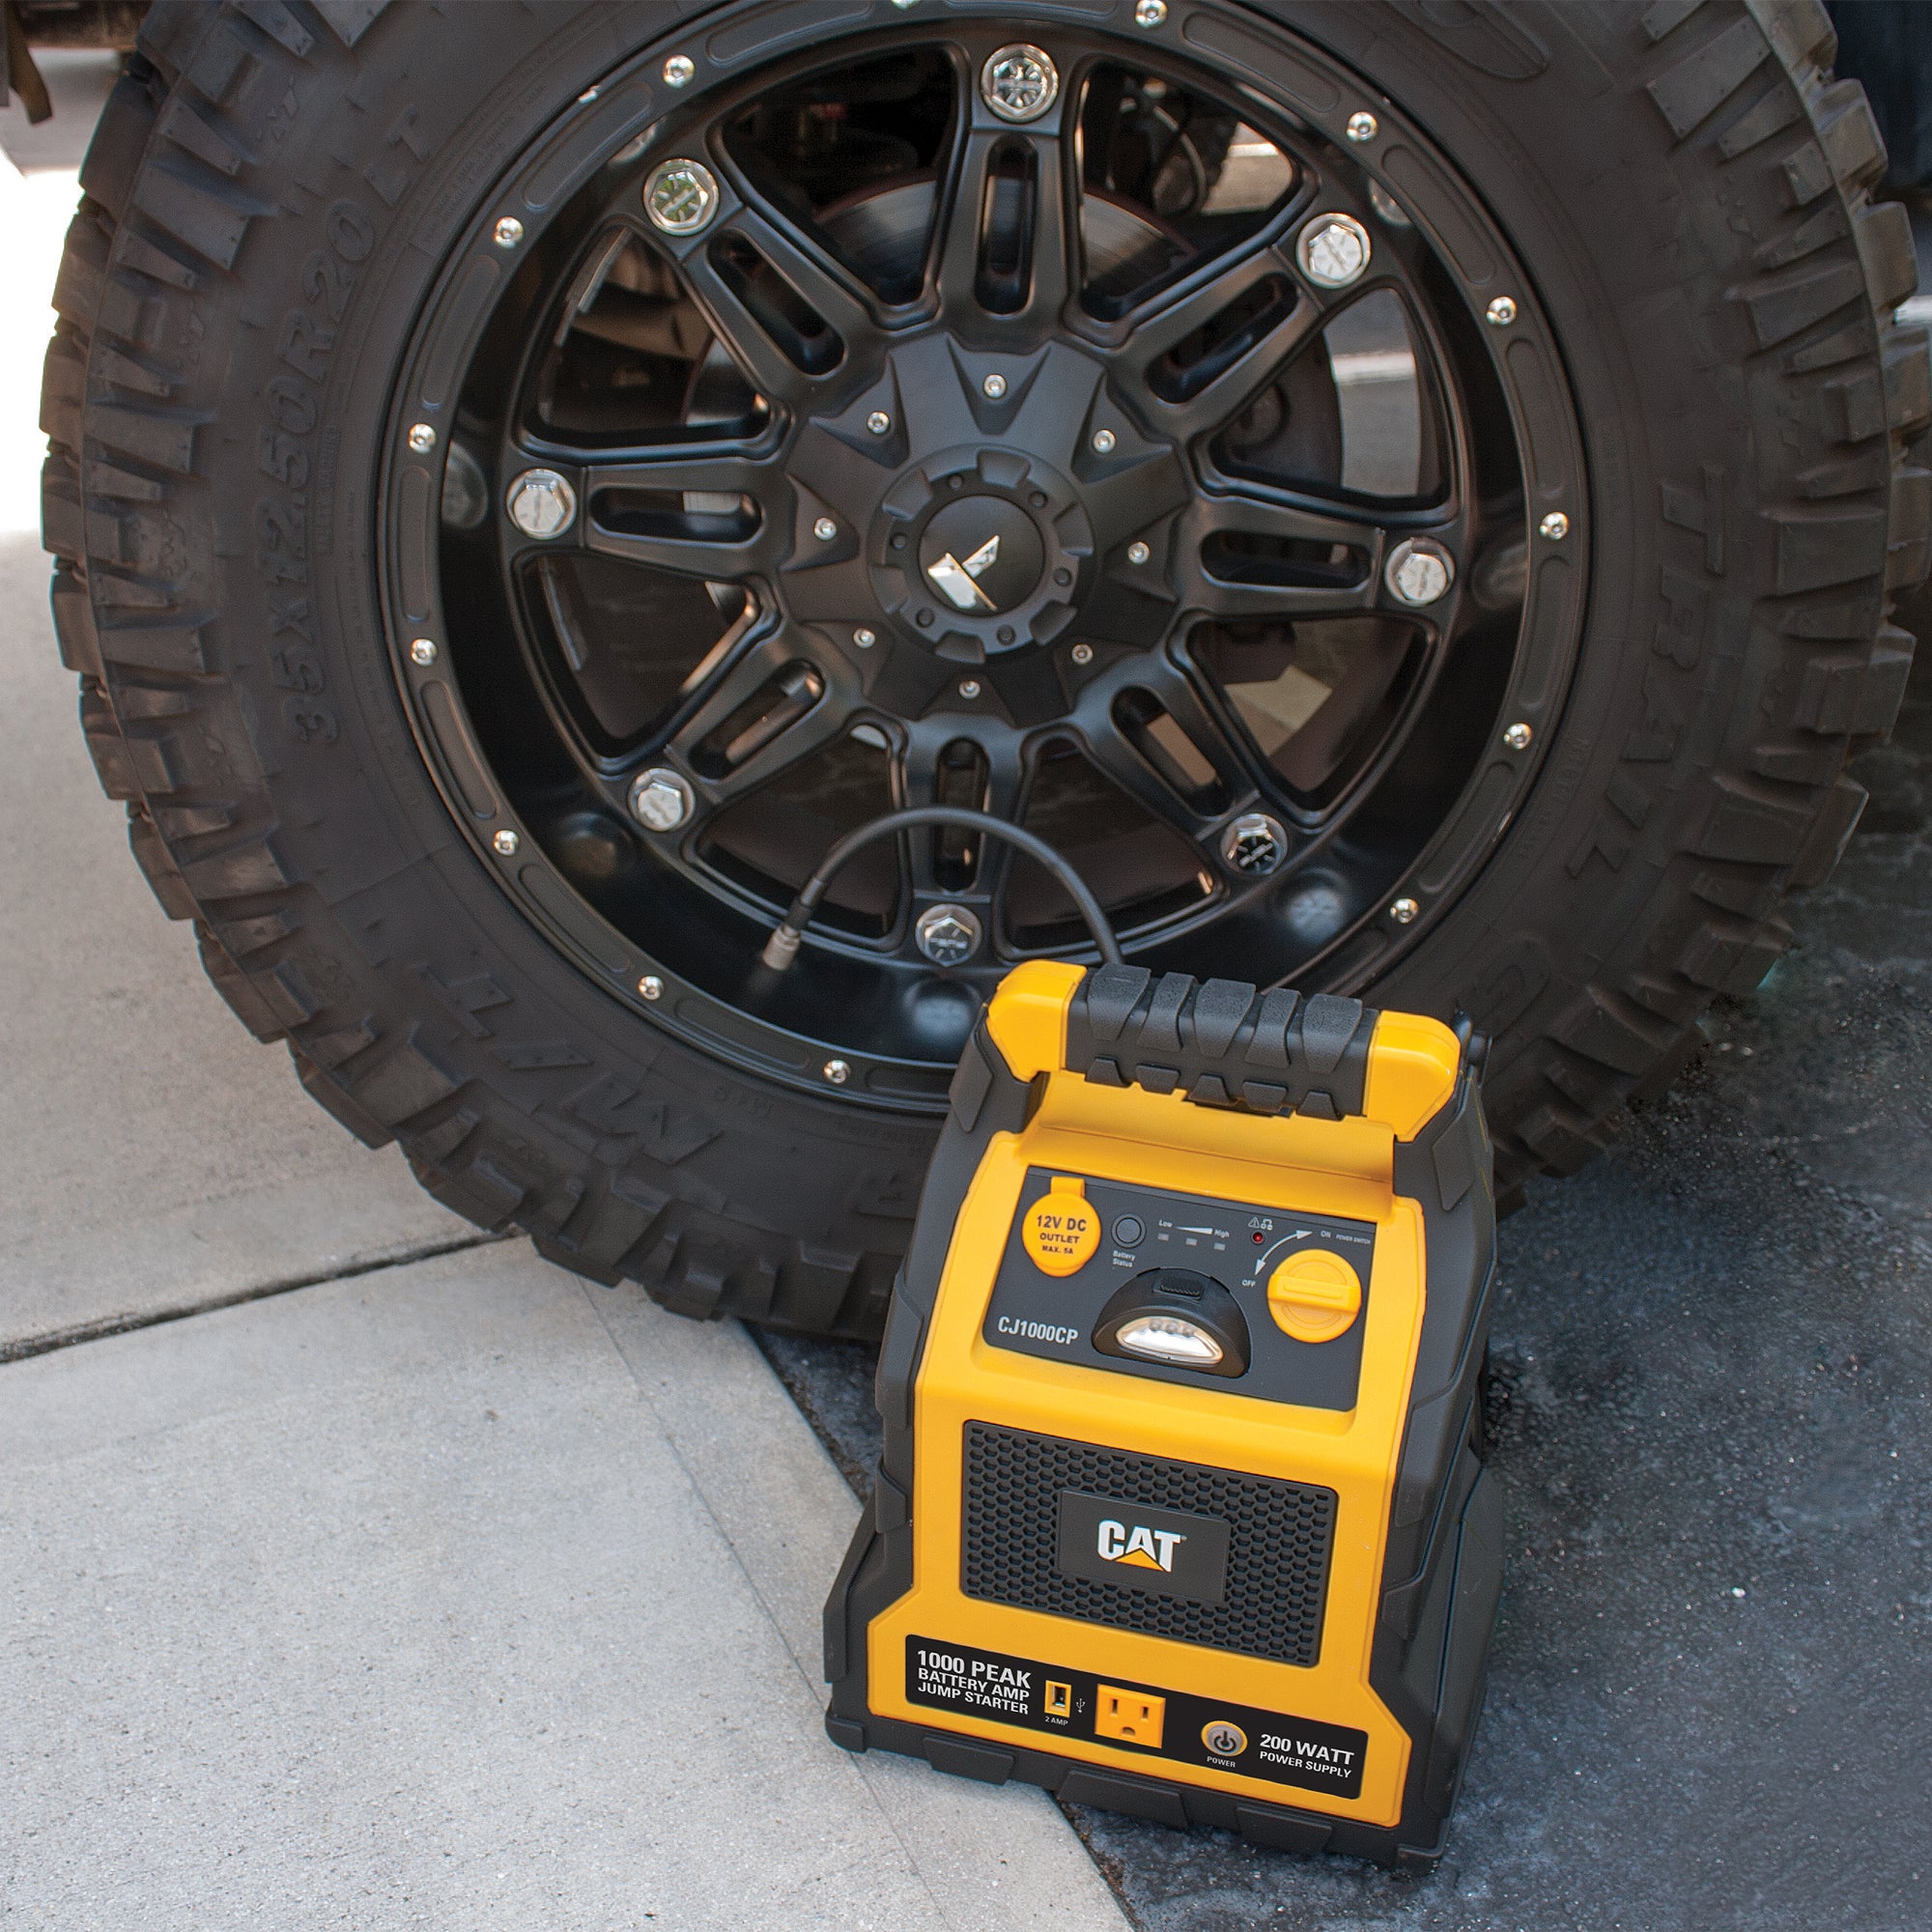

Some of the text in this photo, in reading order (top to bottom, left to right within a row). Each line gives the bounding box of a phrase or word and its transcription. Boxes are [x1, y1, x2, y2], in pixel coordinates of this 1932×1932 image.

[1037, 1214, 1087, 1232] 12V DC
[1158, 1219, 1173, 1228] Low
[1039, 1232, 1080, 1244] OUTLET
[1214, 1228, 1230, 1238] High
[1113, 1250, 1136, 1262] Battery
[1113, 1258, 1133, 1267] Status
[1241, 1279, 1257, 1288] OFF
[998, 1315, 1079, 1346] CJ1000CP
[1096, 1520, 1181, 1573] CAT
[918, 1649, 1032, 1690] 1000 PEAK
[918, 1667, 1030, 1702] BATTERY AMP
[918, 1682, 1029, 1716] JUMP STARTER
[1050, 1717, 1068, 1726] AMP
[1260, 1733, 1354, 1766] 200 WATT
[1207, 1755, 1236, 1769] POWER
[1260, 1750, 1352, 1778] POWER SUPPLY
